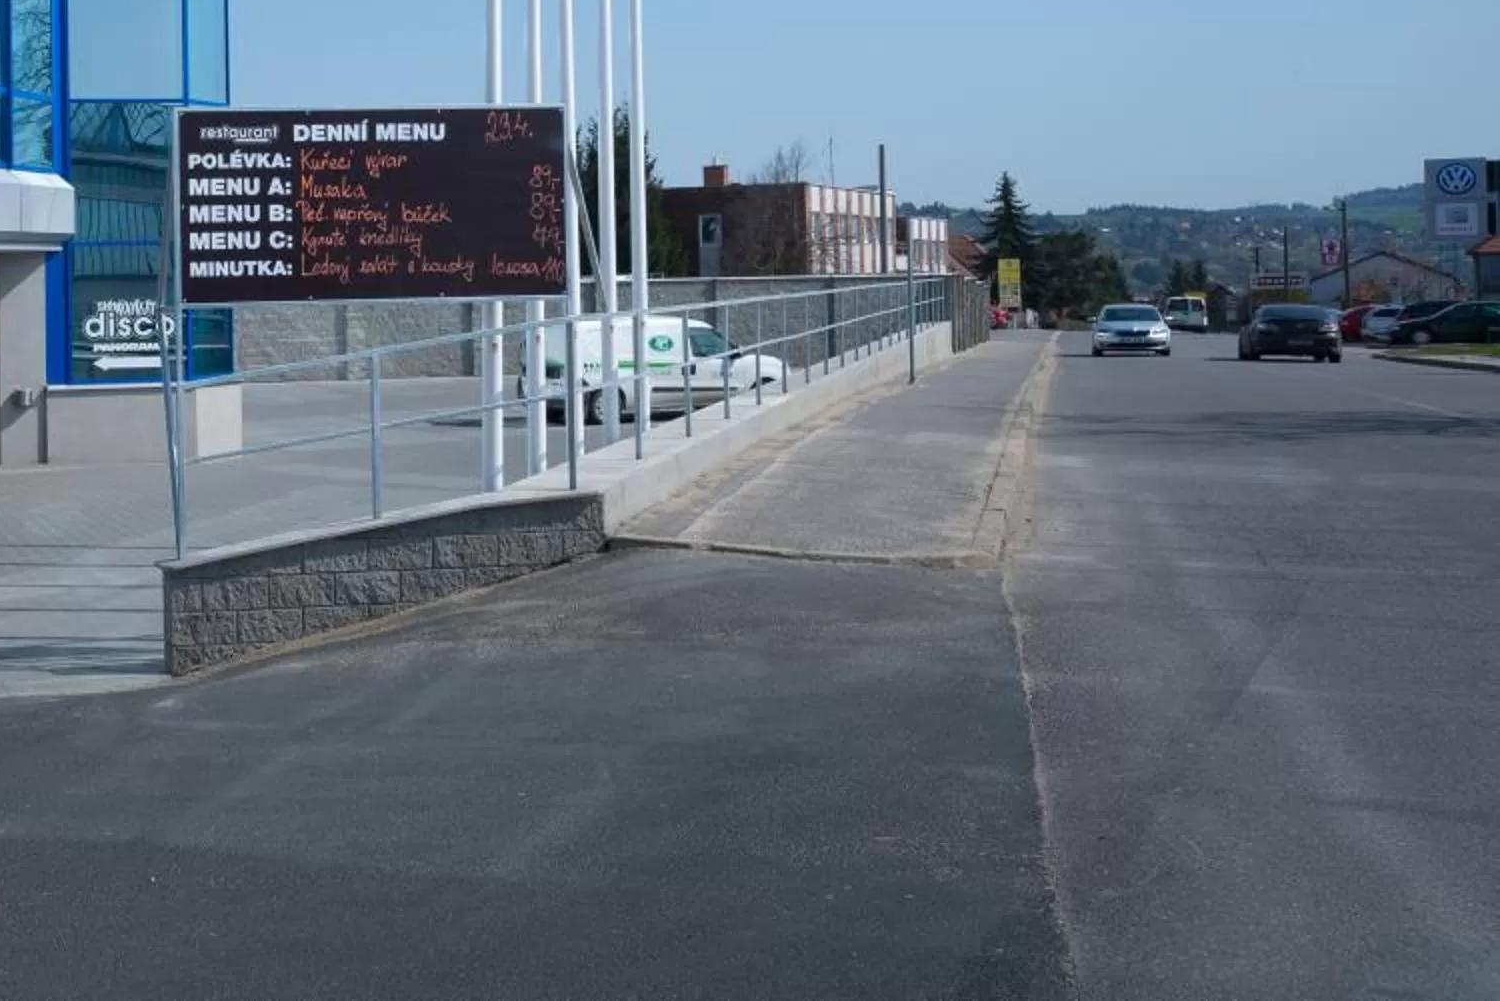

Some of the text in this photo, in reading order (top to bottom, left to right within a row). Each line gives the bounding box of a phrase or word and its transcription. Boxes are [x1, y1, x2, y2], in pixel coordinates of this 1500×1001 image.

[200, 118, 446, 143] restaurant DENNÍ MENU
[188, 150, 292, 170] POLÉVKA:
[189, 177, 293, 196] MENU A:
[189, 204, 293, 224] MENU B:
[189, 230, 293, 250] MENU C:
[189, 261, 293, 277] MINUTKA:
